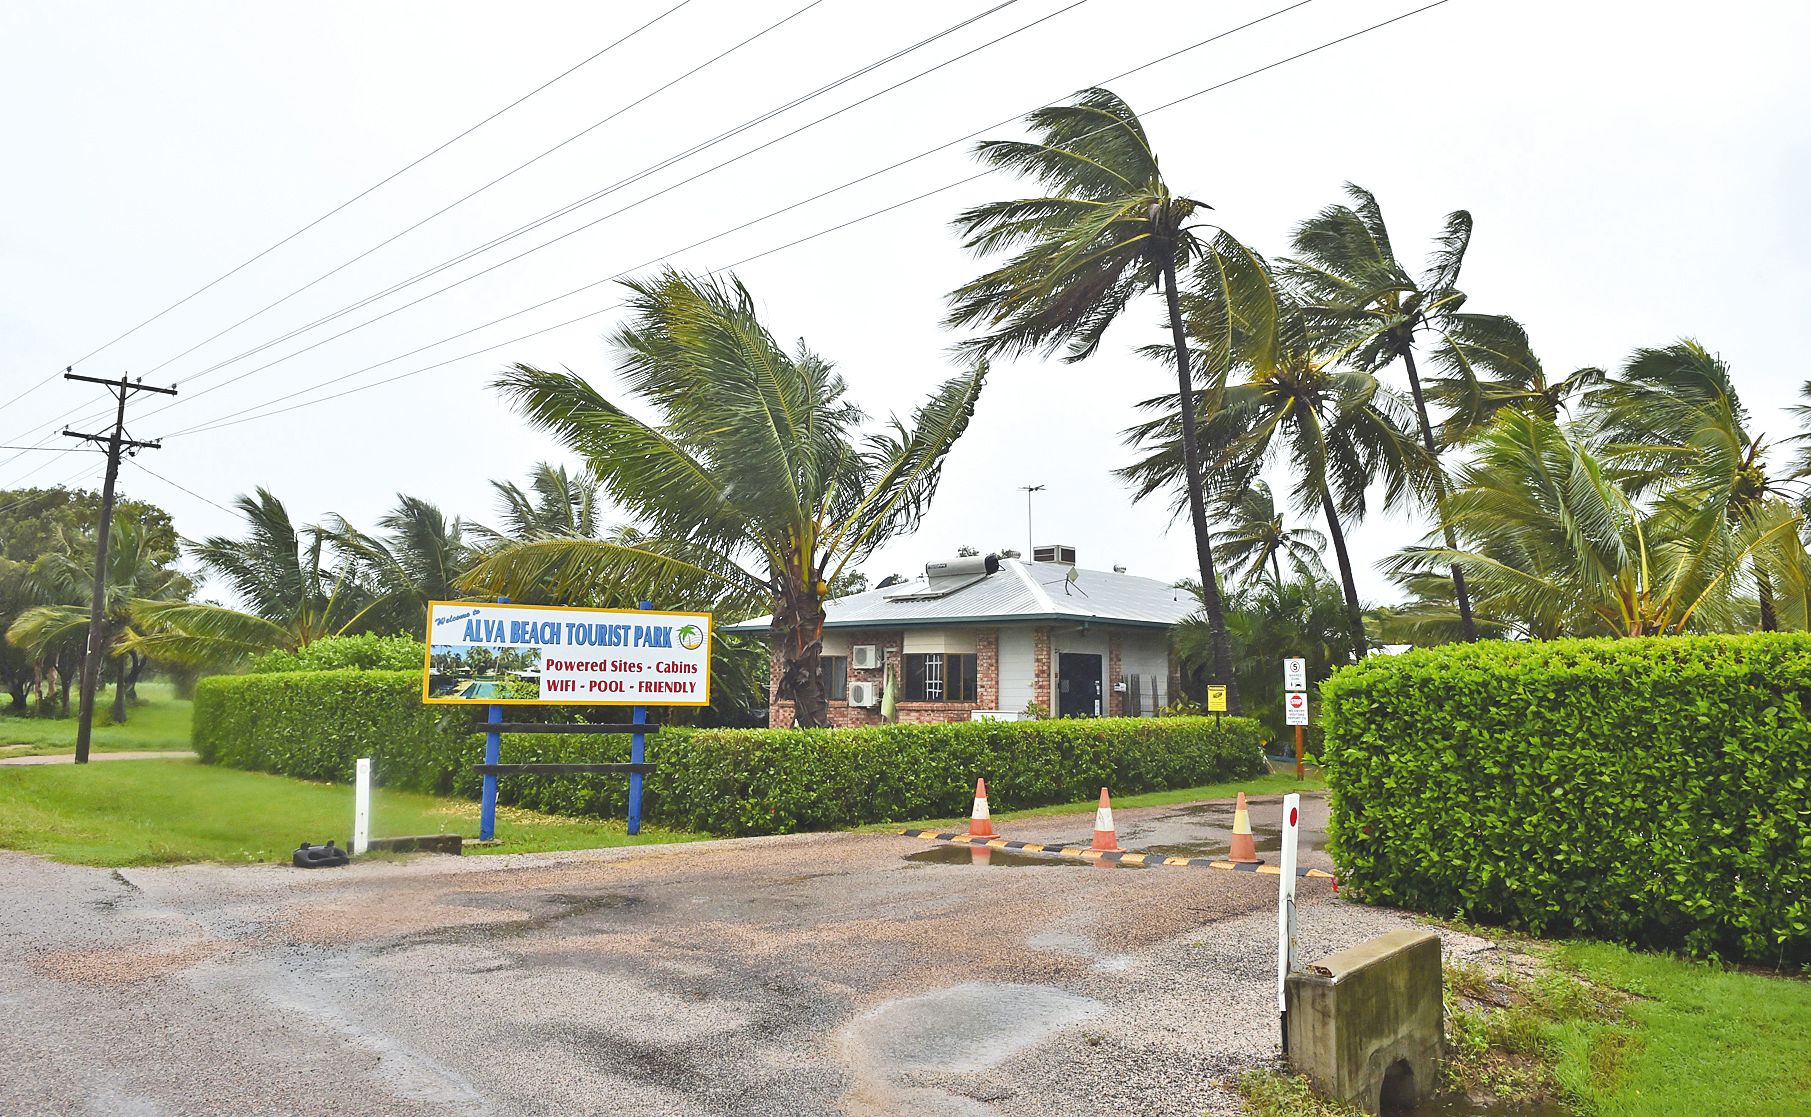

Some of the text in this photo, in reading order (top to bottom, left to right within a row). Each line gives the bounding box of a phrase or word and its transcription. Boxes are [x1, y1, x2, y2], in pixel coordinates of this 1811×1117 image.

[434, 611, 471, 626] Welcome
[462, 618, 673, 648] ALVA BEACH TOURIST PARK
[546, 658, 607, 672] Powered
[610, 659, 643, 673] Sites
[655, 661, 698, 674] Cabins
[546, 679, 576, 692] WIFI
[589, 680, 625, 693] POOL
[638, 681, 697, 694] FRIENDLY
